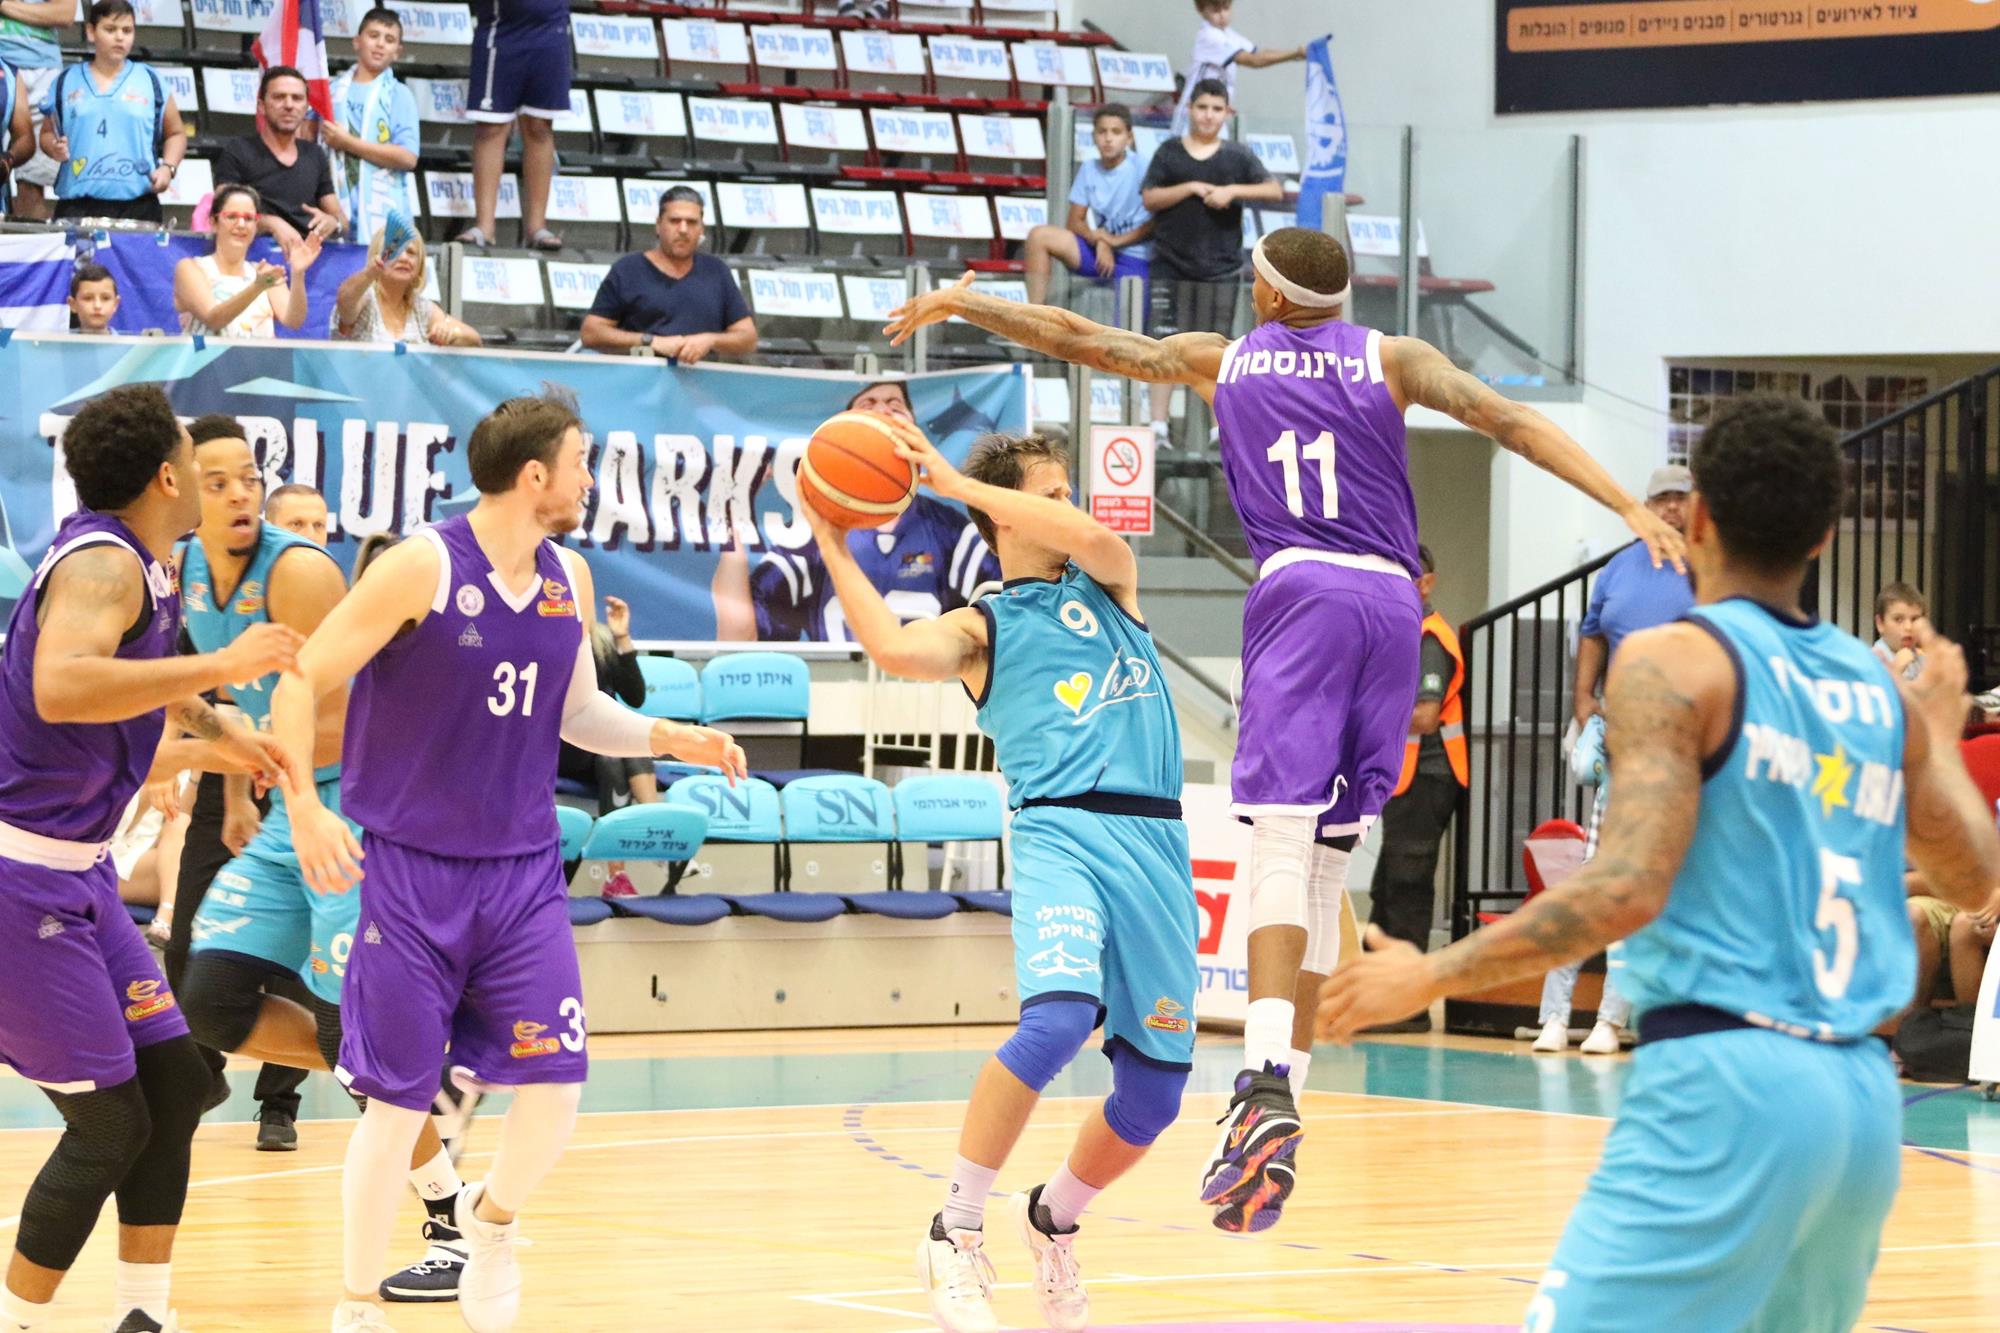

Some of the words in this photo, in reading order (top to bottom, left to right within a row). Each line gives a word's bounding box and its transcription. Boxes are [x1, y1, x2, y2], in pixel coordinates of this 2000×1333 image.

[1519, 22, 1567, 38] הובלות
[1578, 19, 1626, 36] מנופים
[1638, 16, 1679, 33] ניידים
[1683, 14, 1725, 31] מבנים
[1816, 5, 1882, 24] לאירועים
[1890, 5, 1918, 19] ציוד
[97, 117, 108, 138] 4
[234, 416, 450, 540] BLUE
[570, 431, 814, 549] ARKS
[1266, 430, 1339, 519] 11
[1060, 600, 1098, 637] 9
[487, 661, 538, 716] 31
[756, 672, 793, 688] איתן
[689, 784, 752, 822] SN
[815, 786, 879, 828] SN
[1813, 847, 1863, 999] 5
[559, 996, 586, 1052] 3
